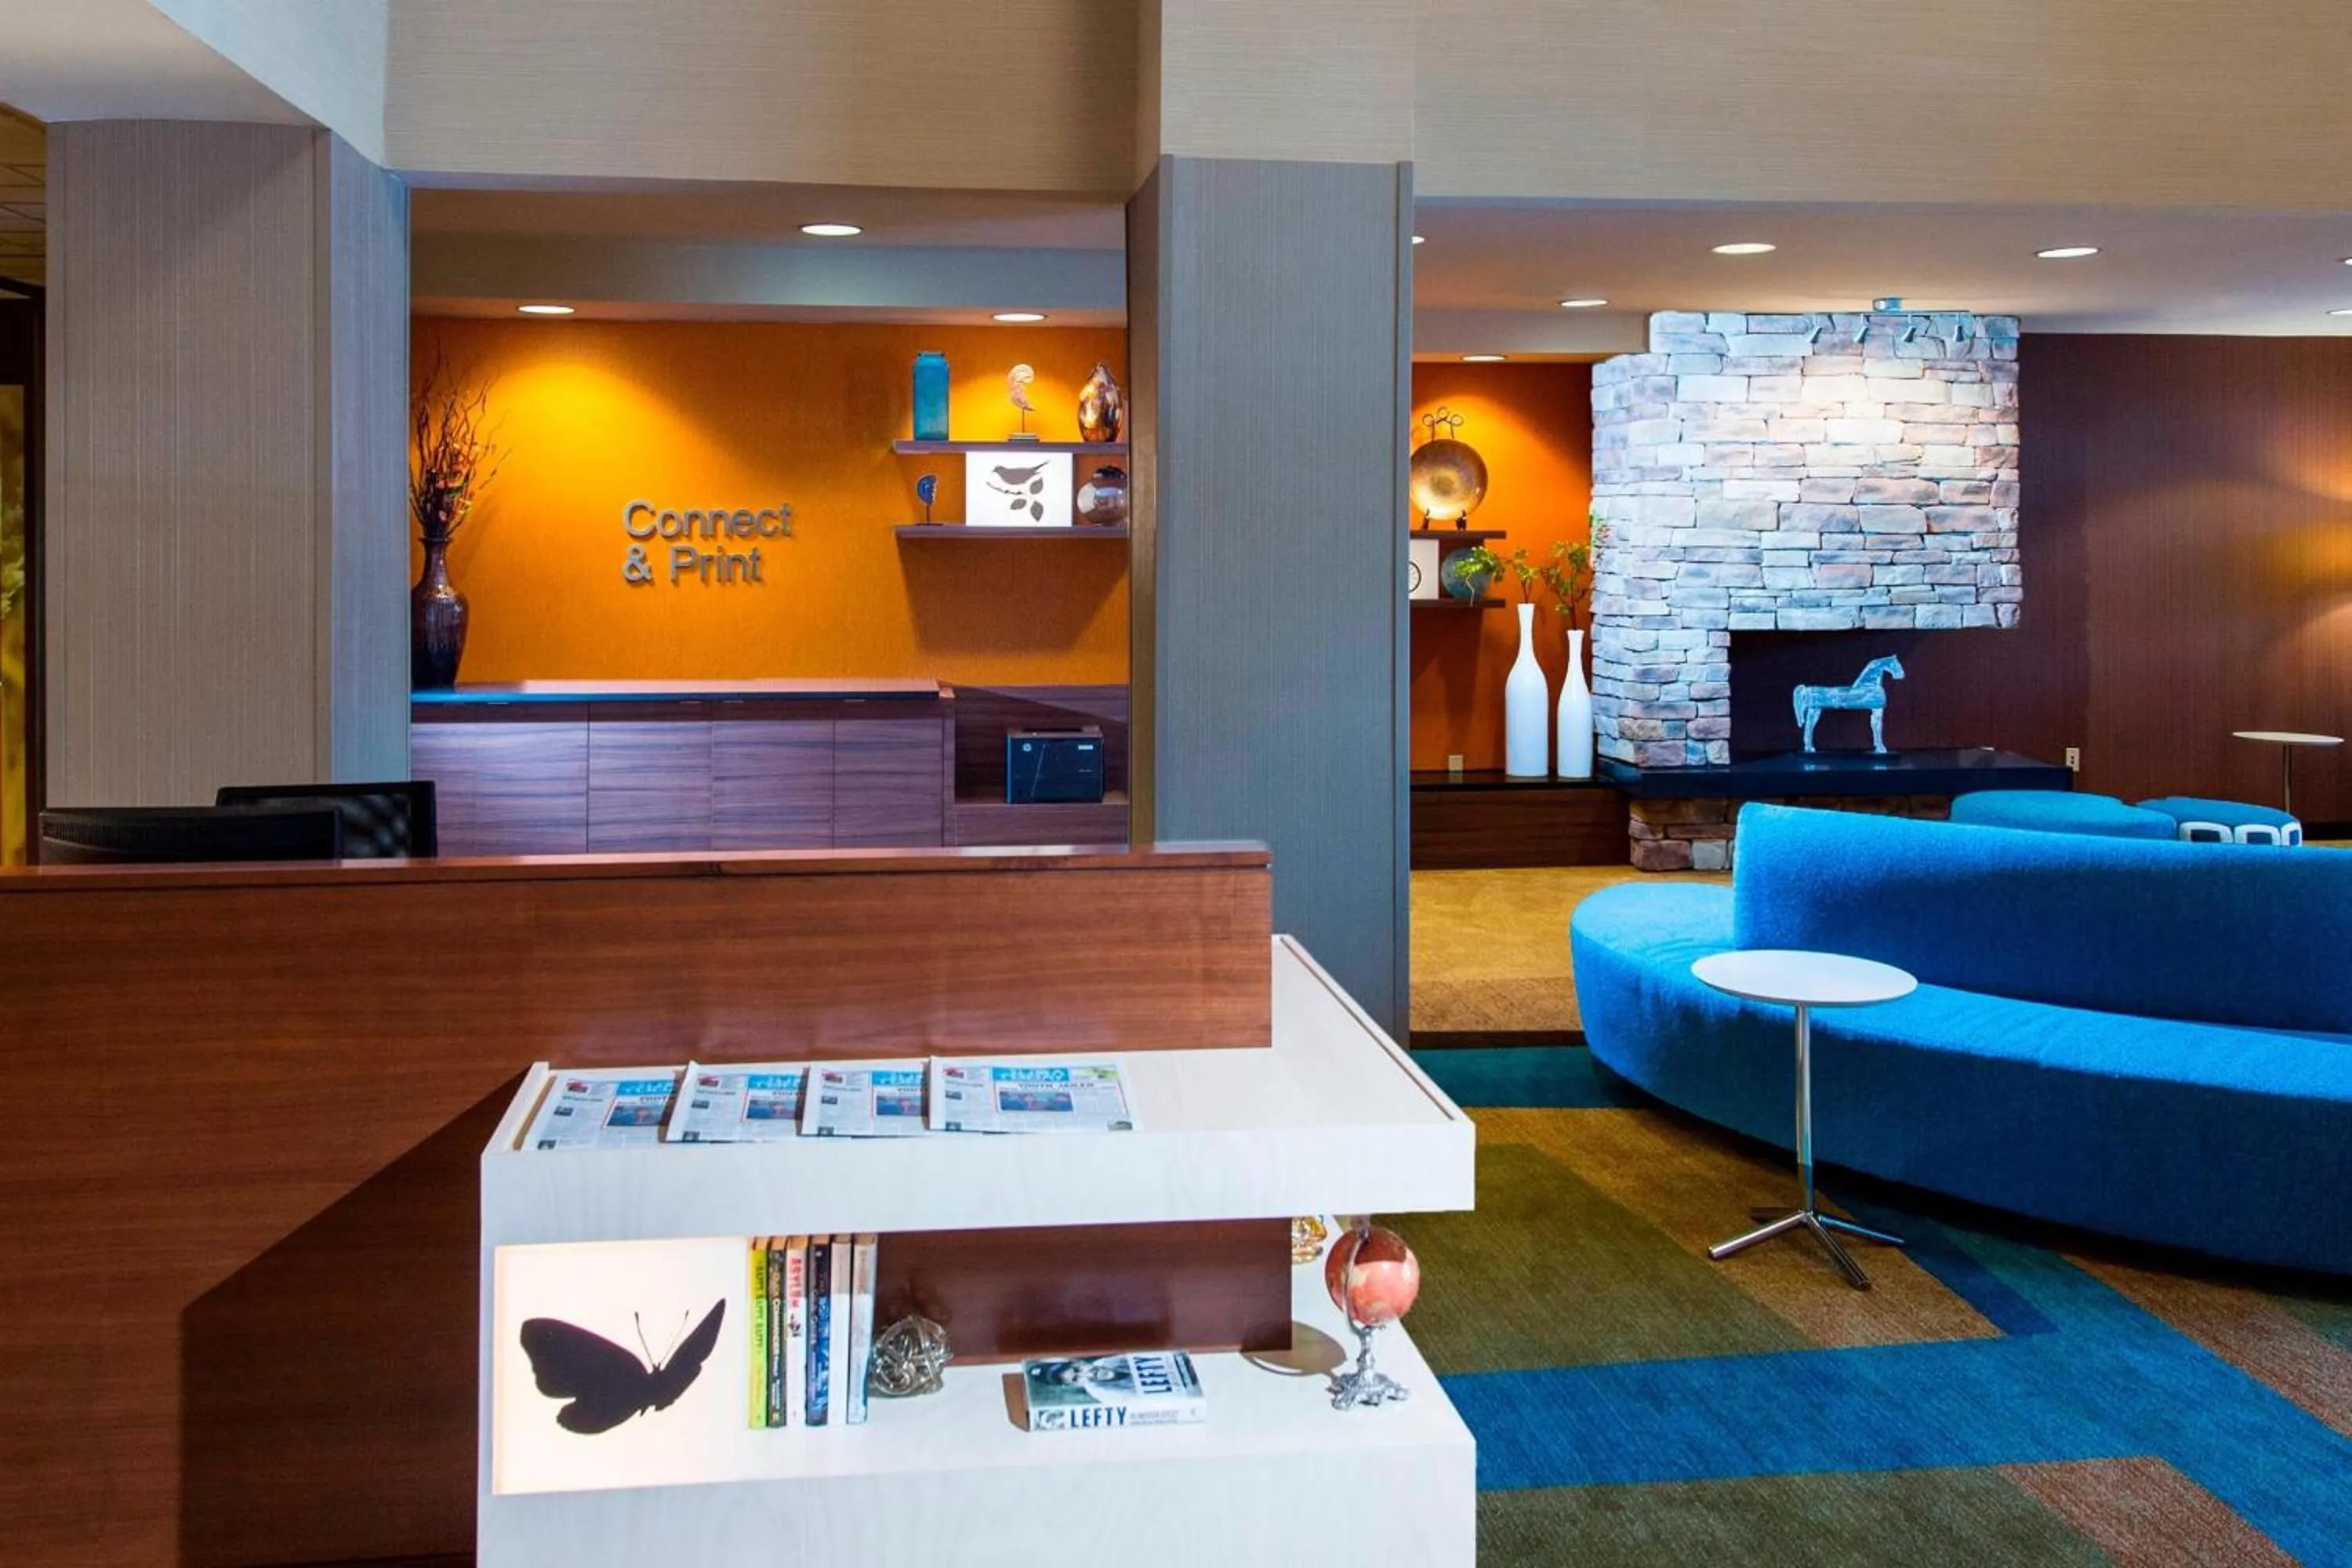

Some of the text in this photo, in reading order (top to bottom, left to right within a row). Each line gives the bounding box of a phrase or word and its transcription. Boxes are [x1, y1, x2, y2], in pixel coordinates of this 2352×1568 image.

[623, 499, 793, 537] Connect
[623, 543, 762, 583] & Print
[789, 1258, 803, 1308] ASYLUM
[1132, 1356, 1173, 1394] LEFTY
[1070, 1406, 1127, 1428] LEFTY
